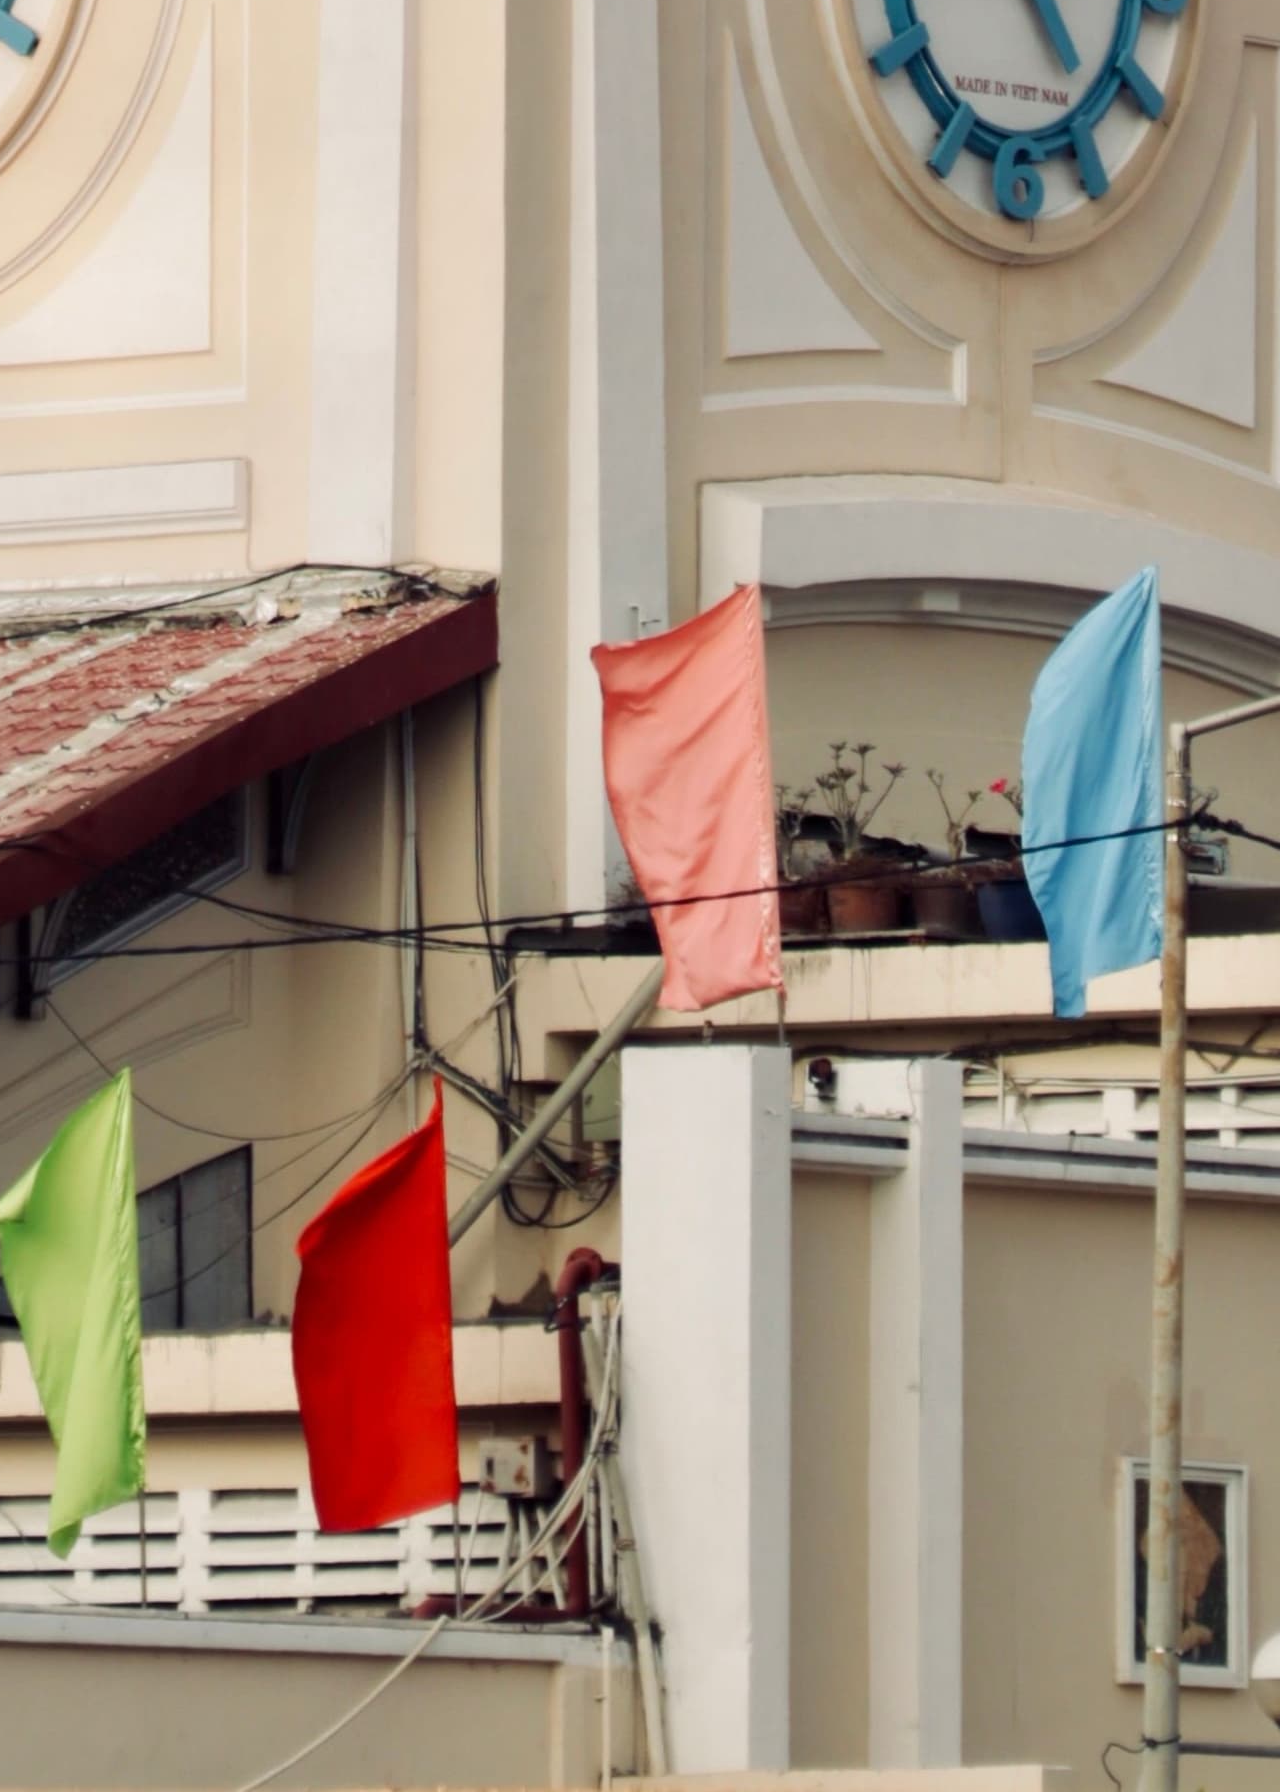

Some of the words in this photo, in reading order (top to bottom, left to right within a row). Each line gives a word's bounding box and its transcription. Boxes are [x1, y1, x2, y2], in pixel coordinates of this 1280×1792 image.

[955, 75, 991, 94] MADE
[995, 80, 1008, 97] IN
[1011, 83, 1039, 102] VIET
[1041, 88, 1069, 107] NAM
[992, 135, 1045, 224] 6
